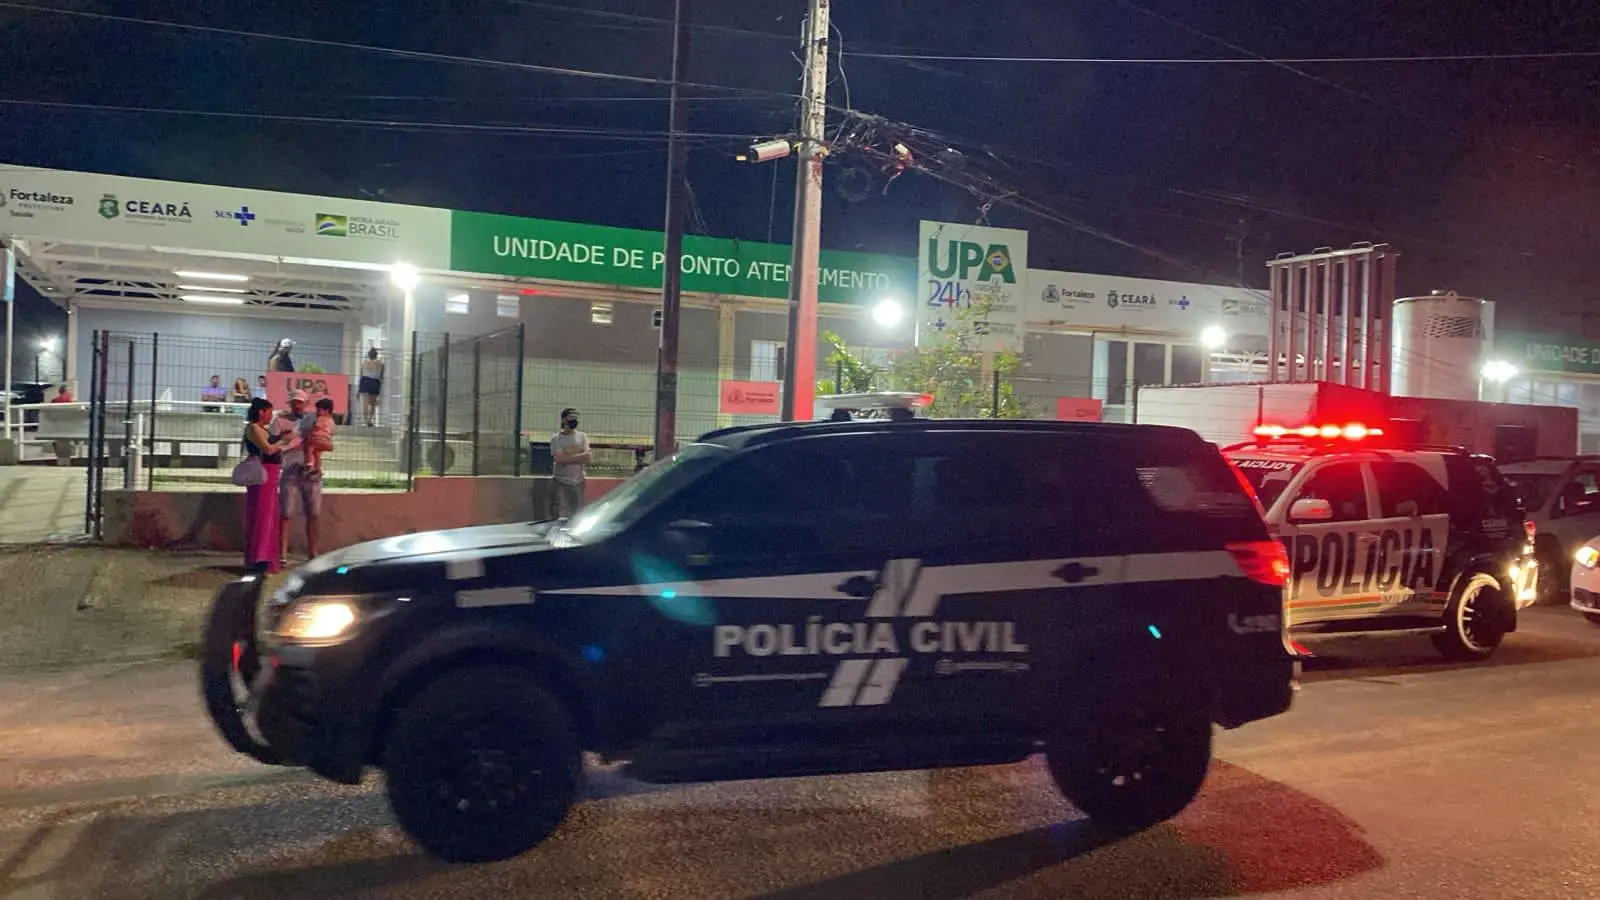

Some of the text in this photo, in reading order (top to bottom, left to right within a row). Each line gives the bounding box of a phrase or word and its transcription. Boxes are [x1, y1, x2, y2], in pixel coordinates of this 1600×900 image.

[10, 188, 74, 205] Fortaleza
[126, 200, 192, 218] CEARÁ
[348, 222, 399, 239] BRASIL
[493, 235, 605, 266] UNIDADE
[613, 248, 644, 269] DE
[652, 251, 741, 278] PONTO
[928, 237, 1017, 284] UPA
[927, 280, 972, 309] 24h
[1121, 293, 1157, 305] CEARÁ
[1526, 343, 1589, 364] UNIDADE
[713, 616, 1029, 657] POLÍCIA CIVIL
